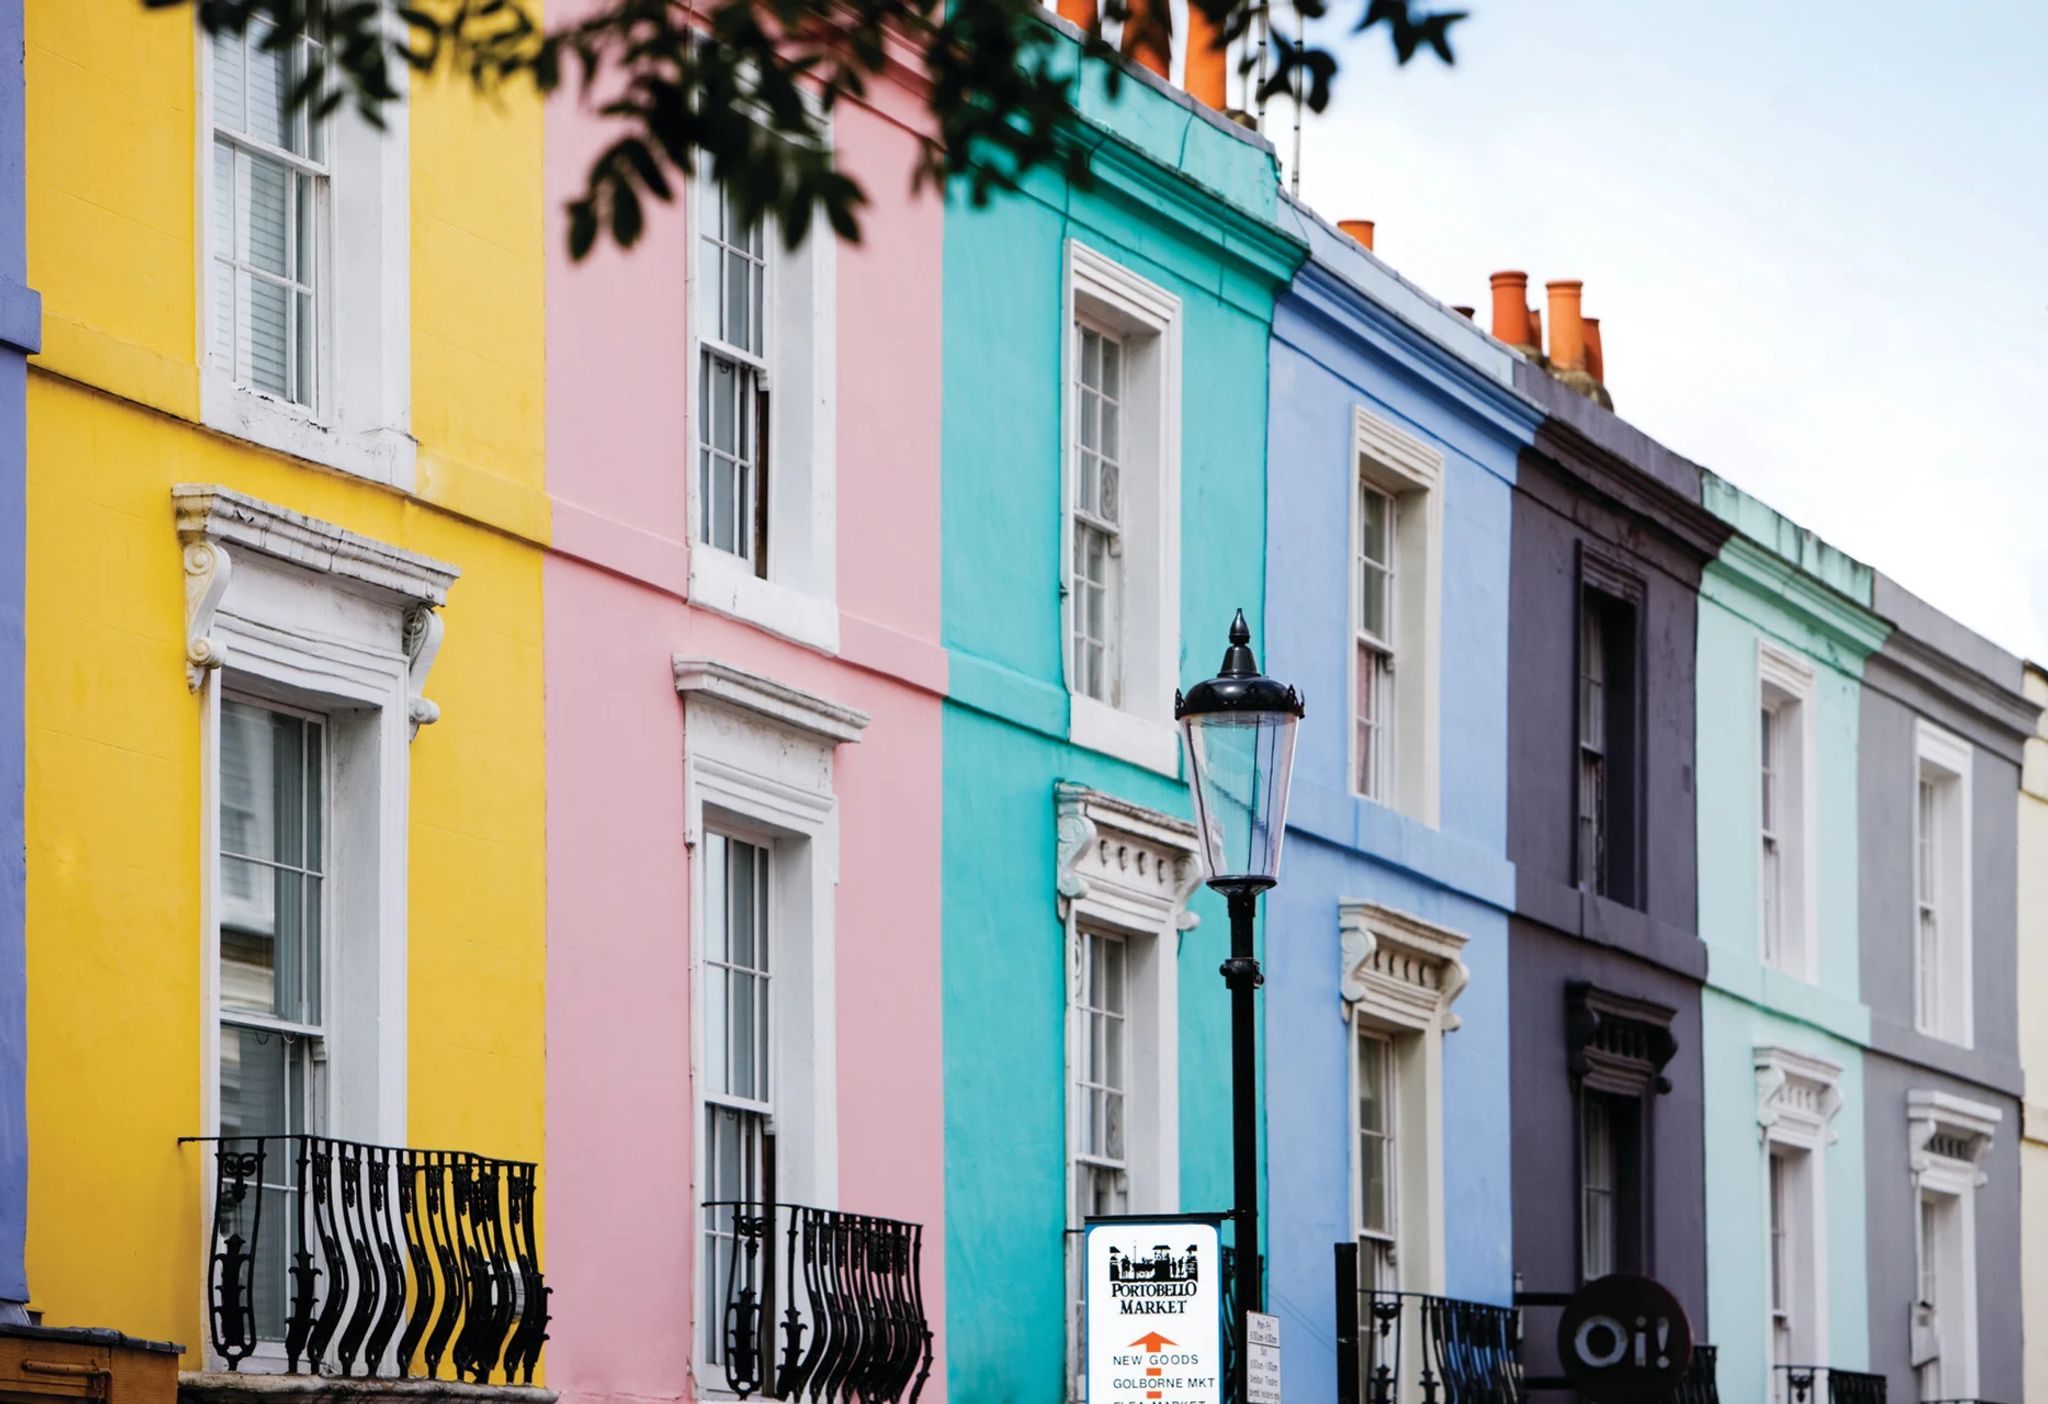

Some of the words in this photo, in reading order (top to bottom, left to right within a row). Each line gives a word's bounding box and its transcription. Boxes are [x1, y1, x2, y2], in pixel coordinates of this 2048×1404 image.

[1111, 1281, 1197, 1298] PORTOBELLO
[1120, 1299, 1187, 1315] MARKET
[1575, 1315, 1671, 1369] Oi!
[1113, 1355, 1143, 1366] NEW
[1149, 1354, 1199, 1365] GOODS
[1113, 1378, 1183, 1389] GOLBORNE
[1187, 1378, 1215, 1388] MKT
